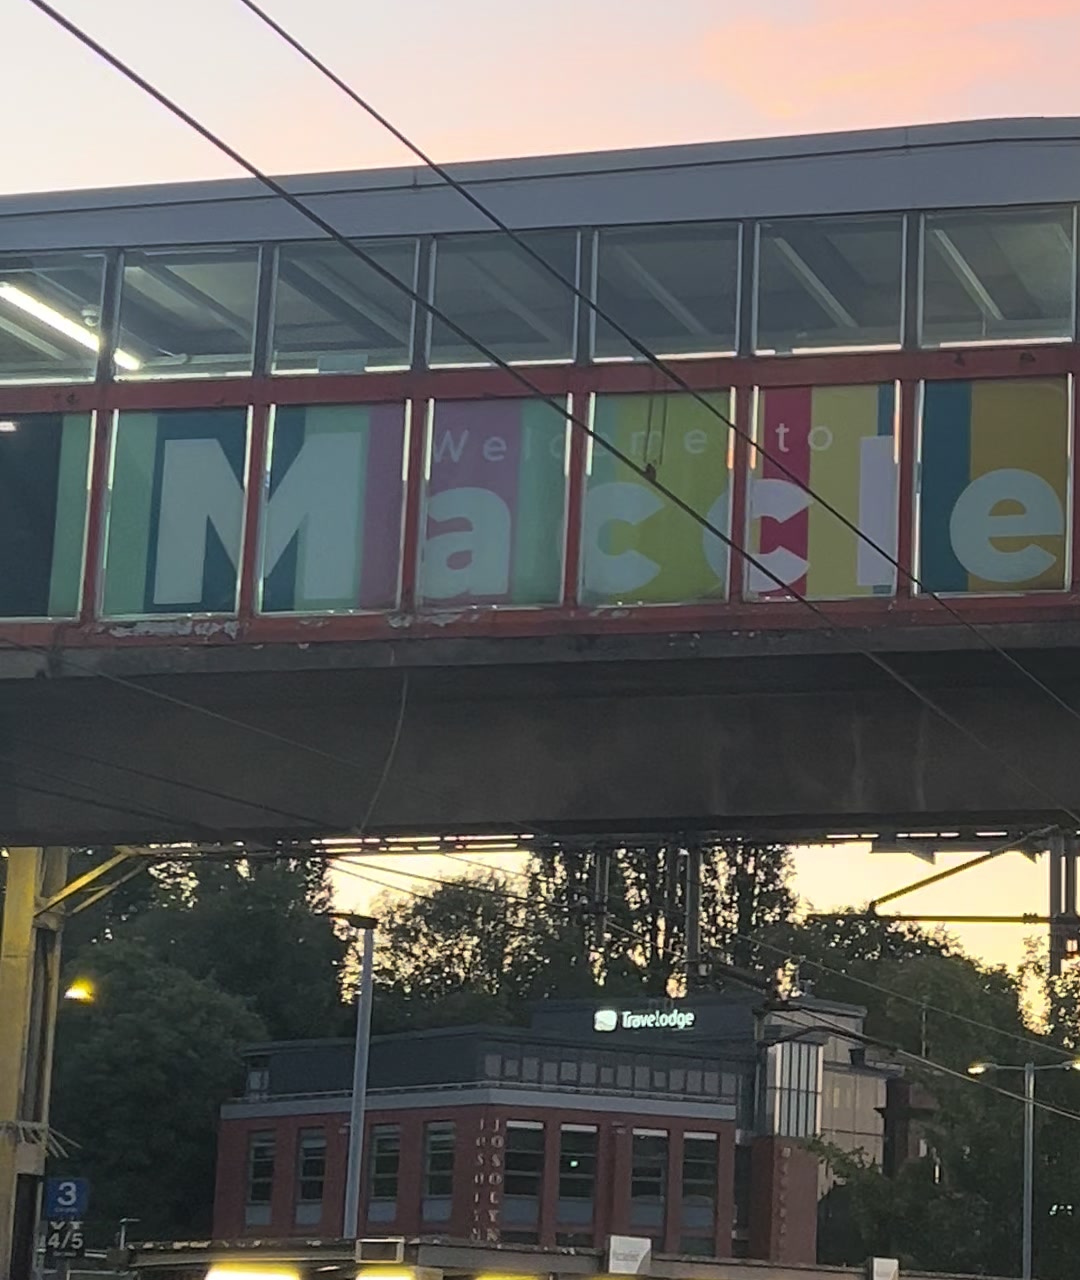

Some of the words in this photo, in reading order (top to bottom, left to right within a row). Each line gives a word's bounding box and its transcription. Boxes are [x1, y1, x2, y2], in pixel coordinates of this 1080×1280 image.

[767, 418, 833, 453] to
[622, 1009, 694, 1029] Travelodge
[57, 1181, 77, 1206] 3
[47, 1232, 83, 1249] 4/5
